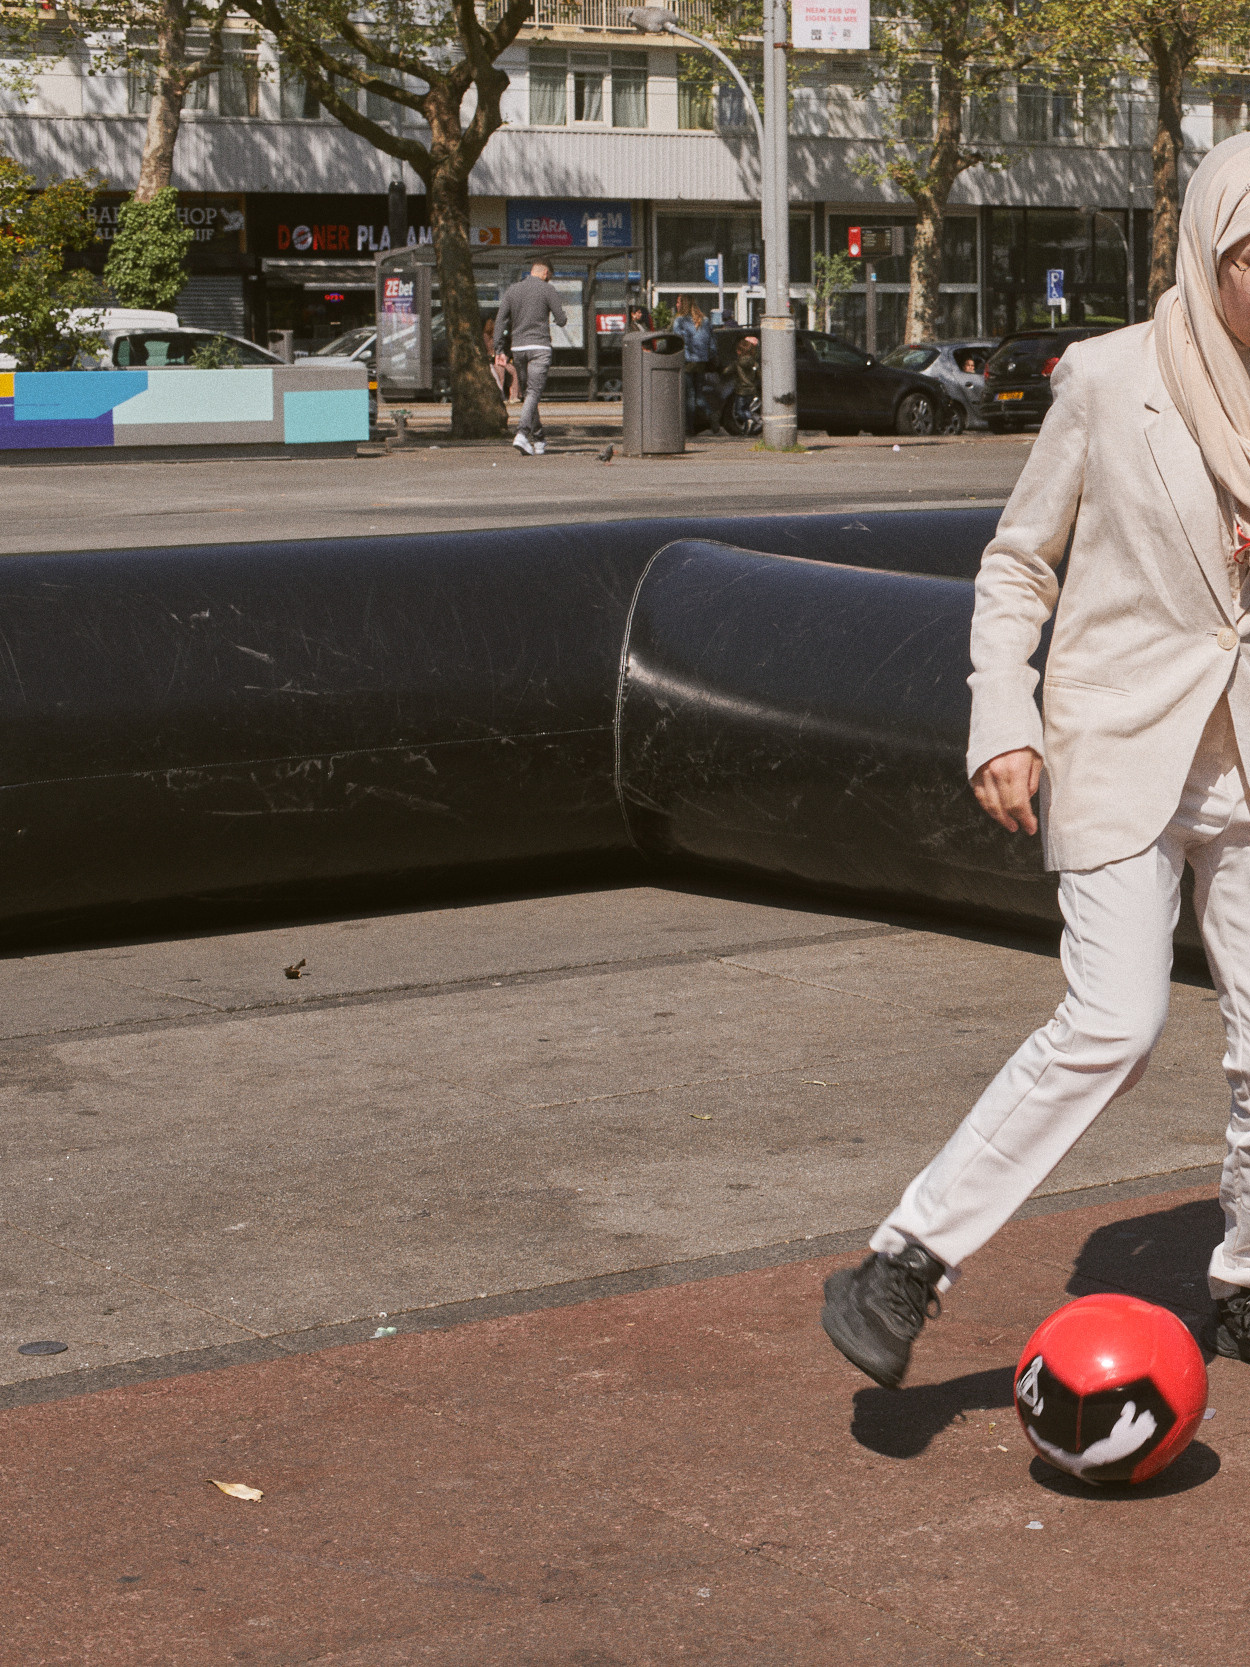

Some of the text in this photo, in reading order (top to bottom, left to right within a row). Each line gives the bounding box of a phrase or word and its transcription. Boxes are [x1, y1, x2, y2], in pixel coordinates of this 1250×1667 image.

[516, 218, 568, 232] LEBARA
[707, 266, 716, 277] P
[1051, 272, 1060, 287] P
[385, 280, 413, 297] ZEbet
